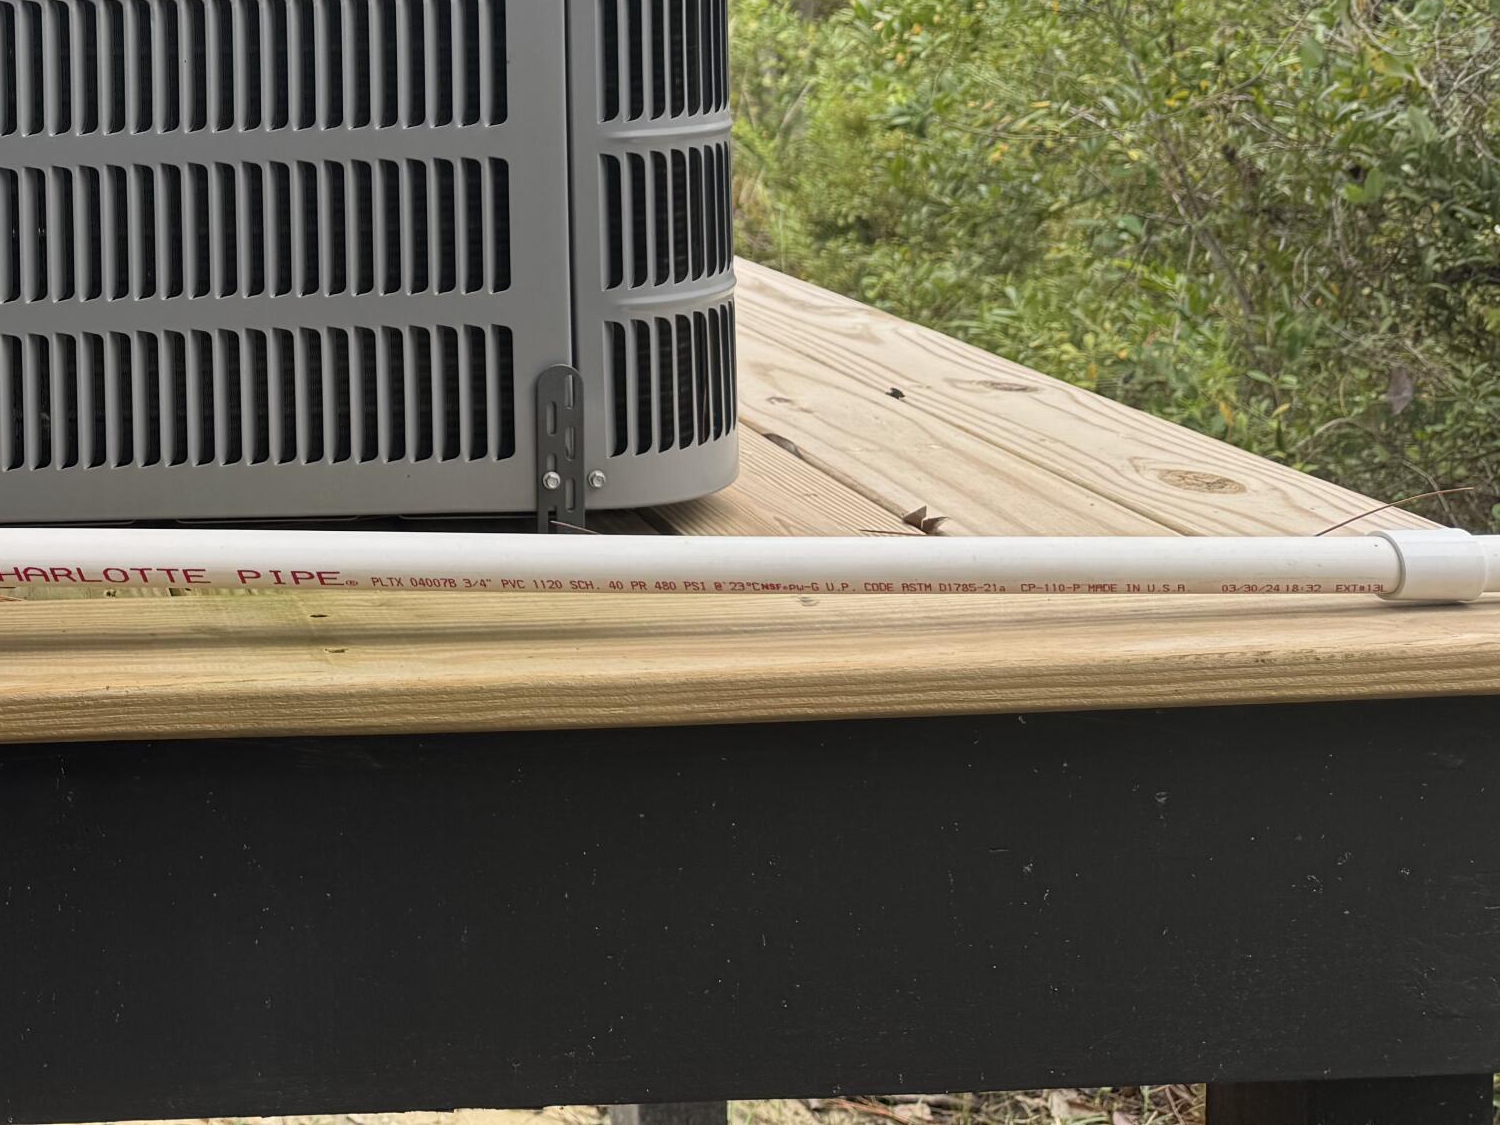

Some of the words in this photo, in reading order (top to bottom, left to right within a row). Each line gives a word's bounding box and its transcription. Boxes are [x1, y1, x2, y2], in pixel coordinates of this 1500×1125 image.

[237, 569, 345, 586] PIPE
[371, 577, 404, 588] PLTX
[463, 578, 492, 589] 3/4"
[501, 579, 526, 589] PVC
[533, 579, 563, 590] 1120
[569, 580, 600, 591] SCH.
[608, 580, 624, 591] 40
[630, 581, 648, 591] PR
[654, 581, 677, 591] 480
[684, 581, 707, 591] PSI
[864, 582, 894, 592] CODE
[902, 583, 932, 592] ASTM
[939, 583, 1006, 592] D1785-21a
[1020, 583, 1081, 592] CP-110-P
[1088, 584, 1118, 593] MADE
[1126, 584, 1141, 592] IN
[1221, 584, 1281, 593] 03/30/24
[1284, 584, 1322, 593] 18:32
